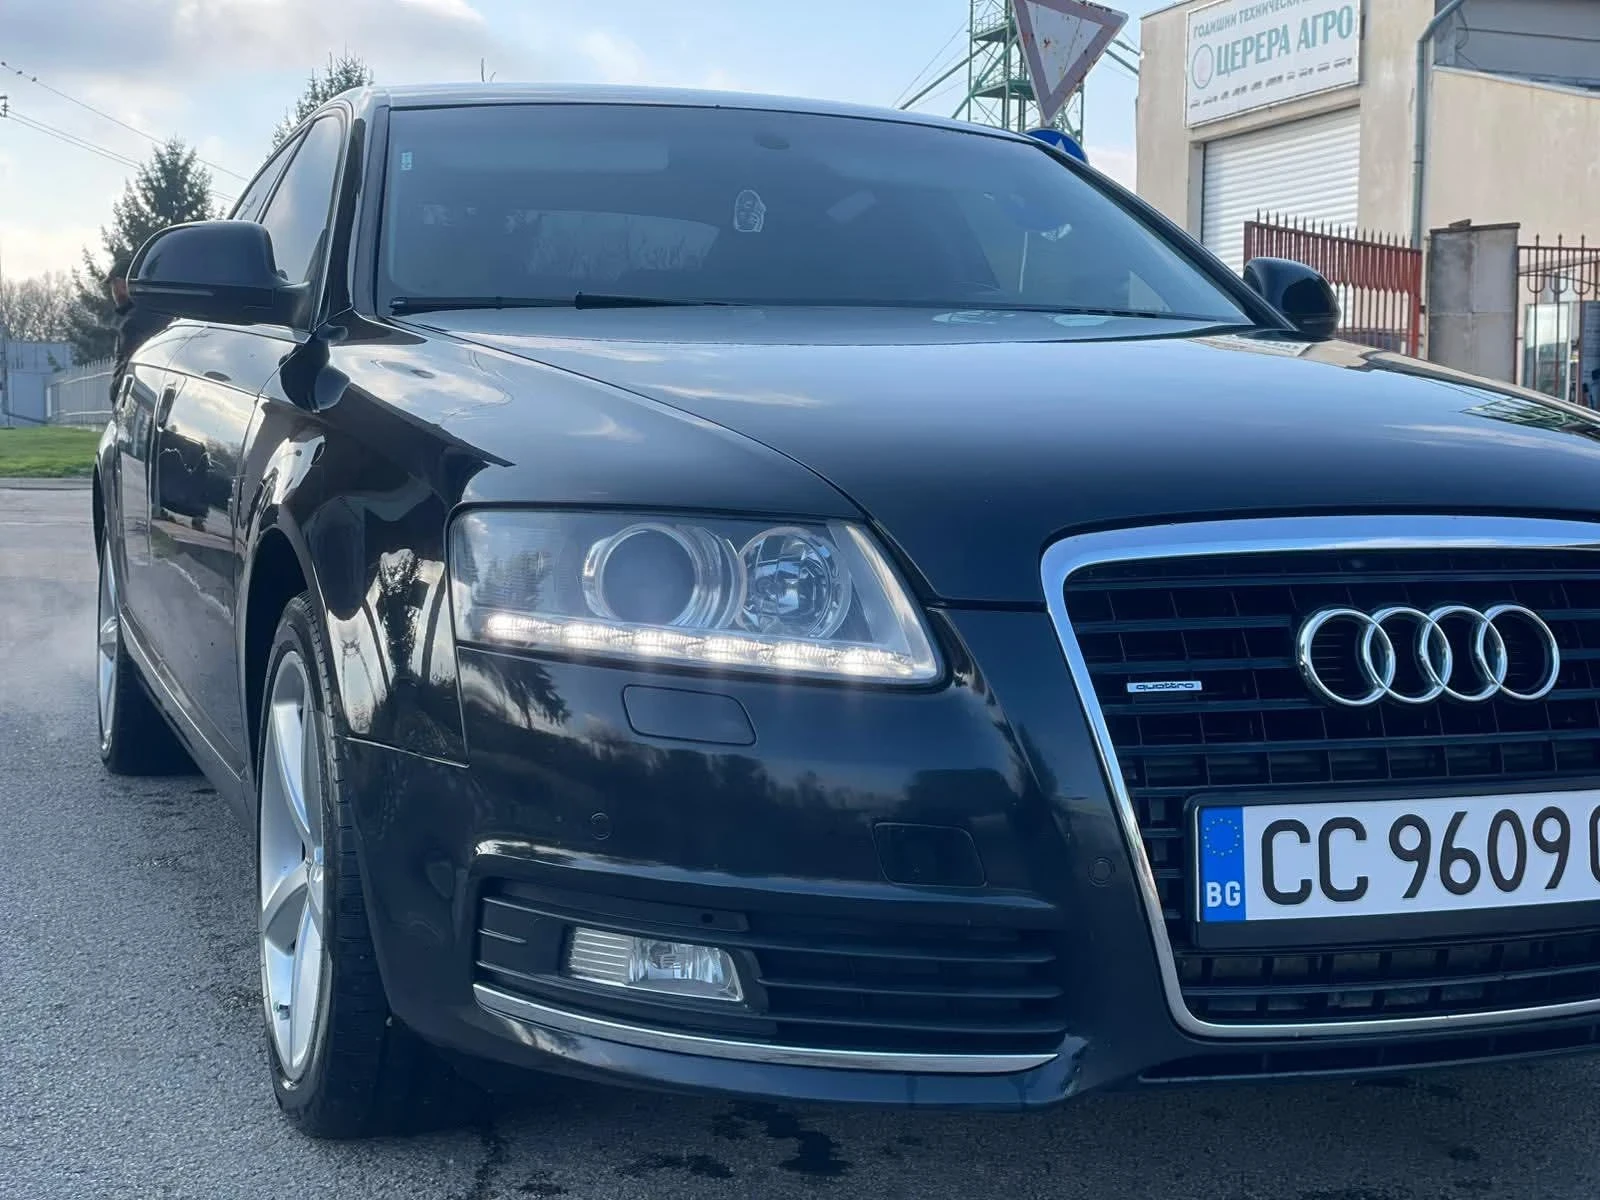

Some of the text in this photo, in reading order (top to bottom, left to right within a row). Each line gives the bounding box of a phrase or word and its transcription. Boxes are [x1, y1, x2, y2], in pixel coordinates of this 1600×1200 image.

[1193, 13, 1237, 39] ГОДИШНИ
[1216, 5, 1353, 77] ЦЕРЕРА АГРО
[1136, 682, 1194, 691] quattro
[1260, 816, 1369, 906] CC
[1388, 806, 1571, 899] 9609
[1205, 880, 1241, 908] BG
